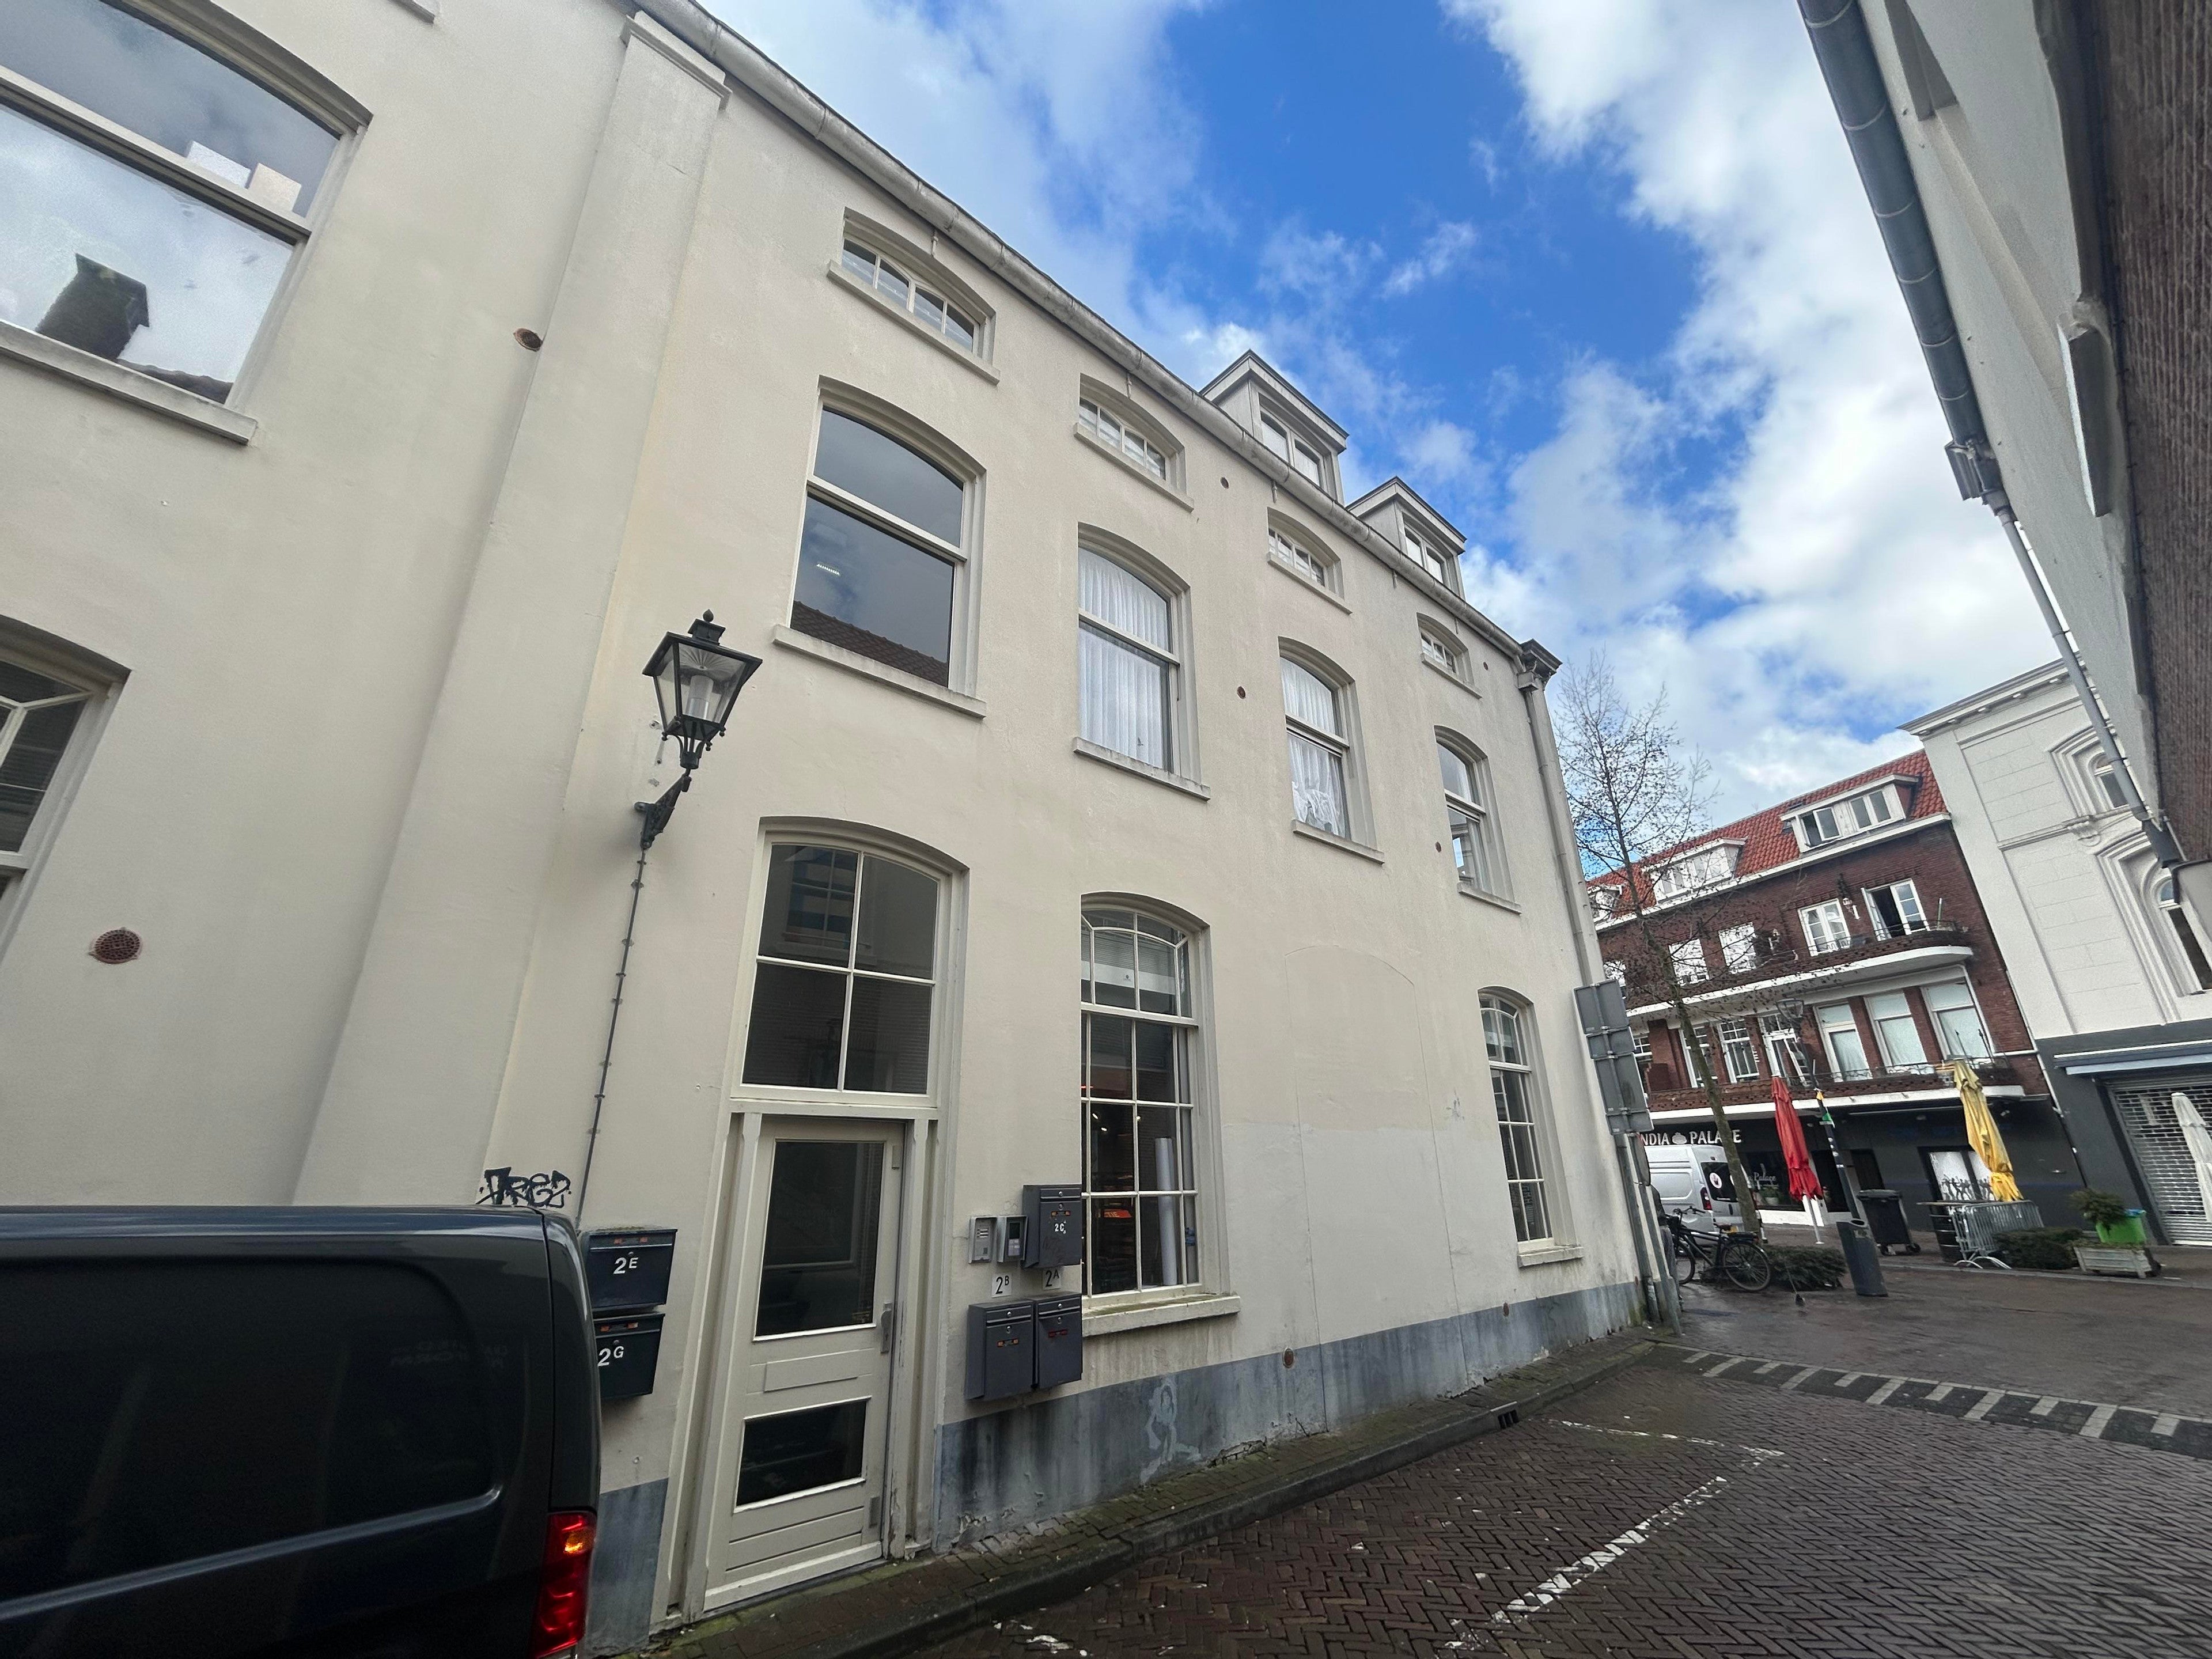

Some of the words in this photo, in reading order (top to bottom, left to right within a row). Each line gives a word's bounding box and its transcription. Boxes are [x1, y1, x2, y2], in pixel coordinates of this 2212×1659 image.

[1641, 1132, 1670, 1146] NDIA
[1689, 1130, 1741, 1145] PALAE
[613, 1257, 639, 1274] 2E
[995, 1275, 1010, 1294] 2B
[1046, 1268, 1059, 1287] 2A
[597, 1346, 624, 1367] 2G
